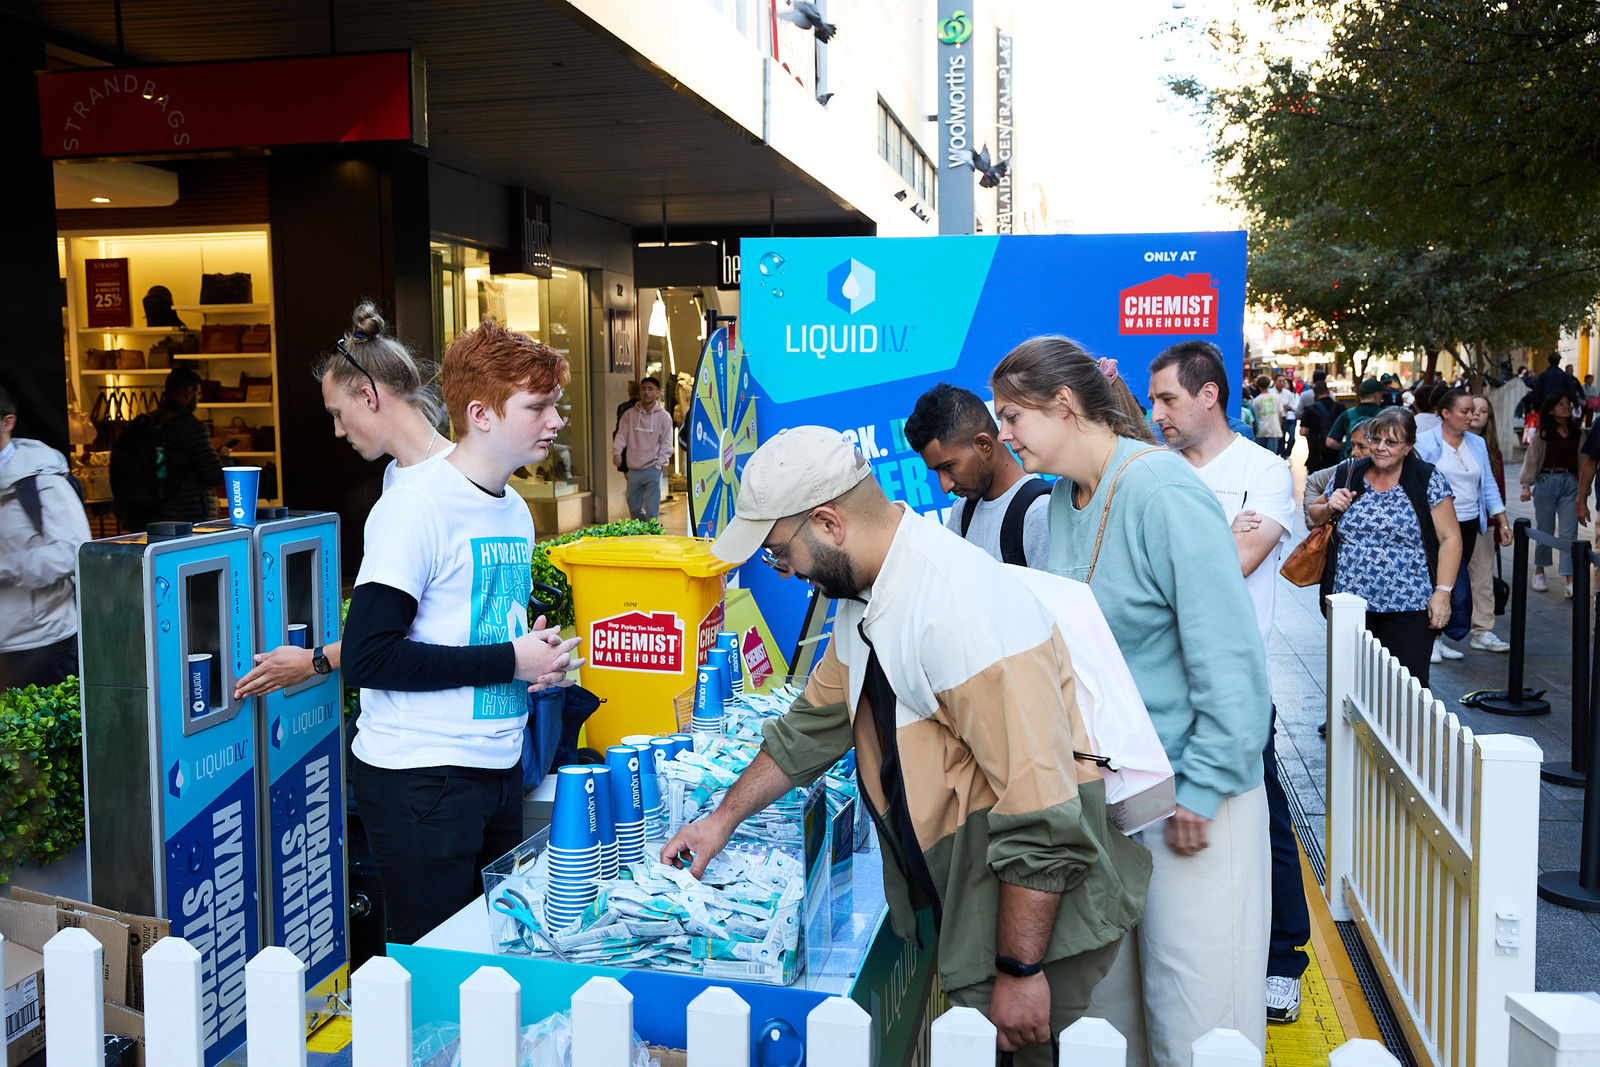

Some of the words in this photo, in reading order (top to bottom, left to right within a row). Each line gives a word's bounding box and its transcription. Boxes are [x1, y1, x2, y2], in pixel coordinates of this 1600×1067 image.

[63, 74, 190, 151] STRANDBAGS
[999, 85, 1012, 159] CENTRAL
[1144, 252, 1178, 262] ONLY
[1180, 251, 1197, 261] AT
[95, 293, 122, 308] 25%
[1124, 295, 1213, 316] CHEMIST
[1124, 317, 1209, 328] WAREHOUSE
[786, 325, 878, 359] LIQUID
[594, 629, 678, 653] CHEMIST
[594, 650, 675, 665] WAREHOUSE
[292, 705, 324, 735] LIQUID
[195, 745, 234, 781] LIQUID
[305, 754, 334, 972] HYDRATION
[281, 823, 312, 972] STATION
[212, 800, 248, 1038] HYDRATION
